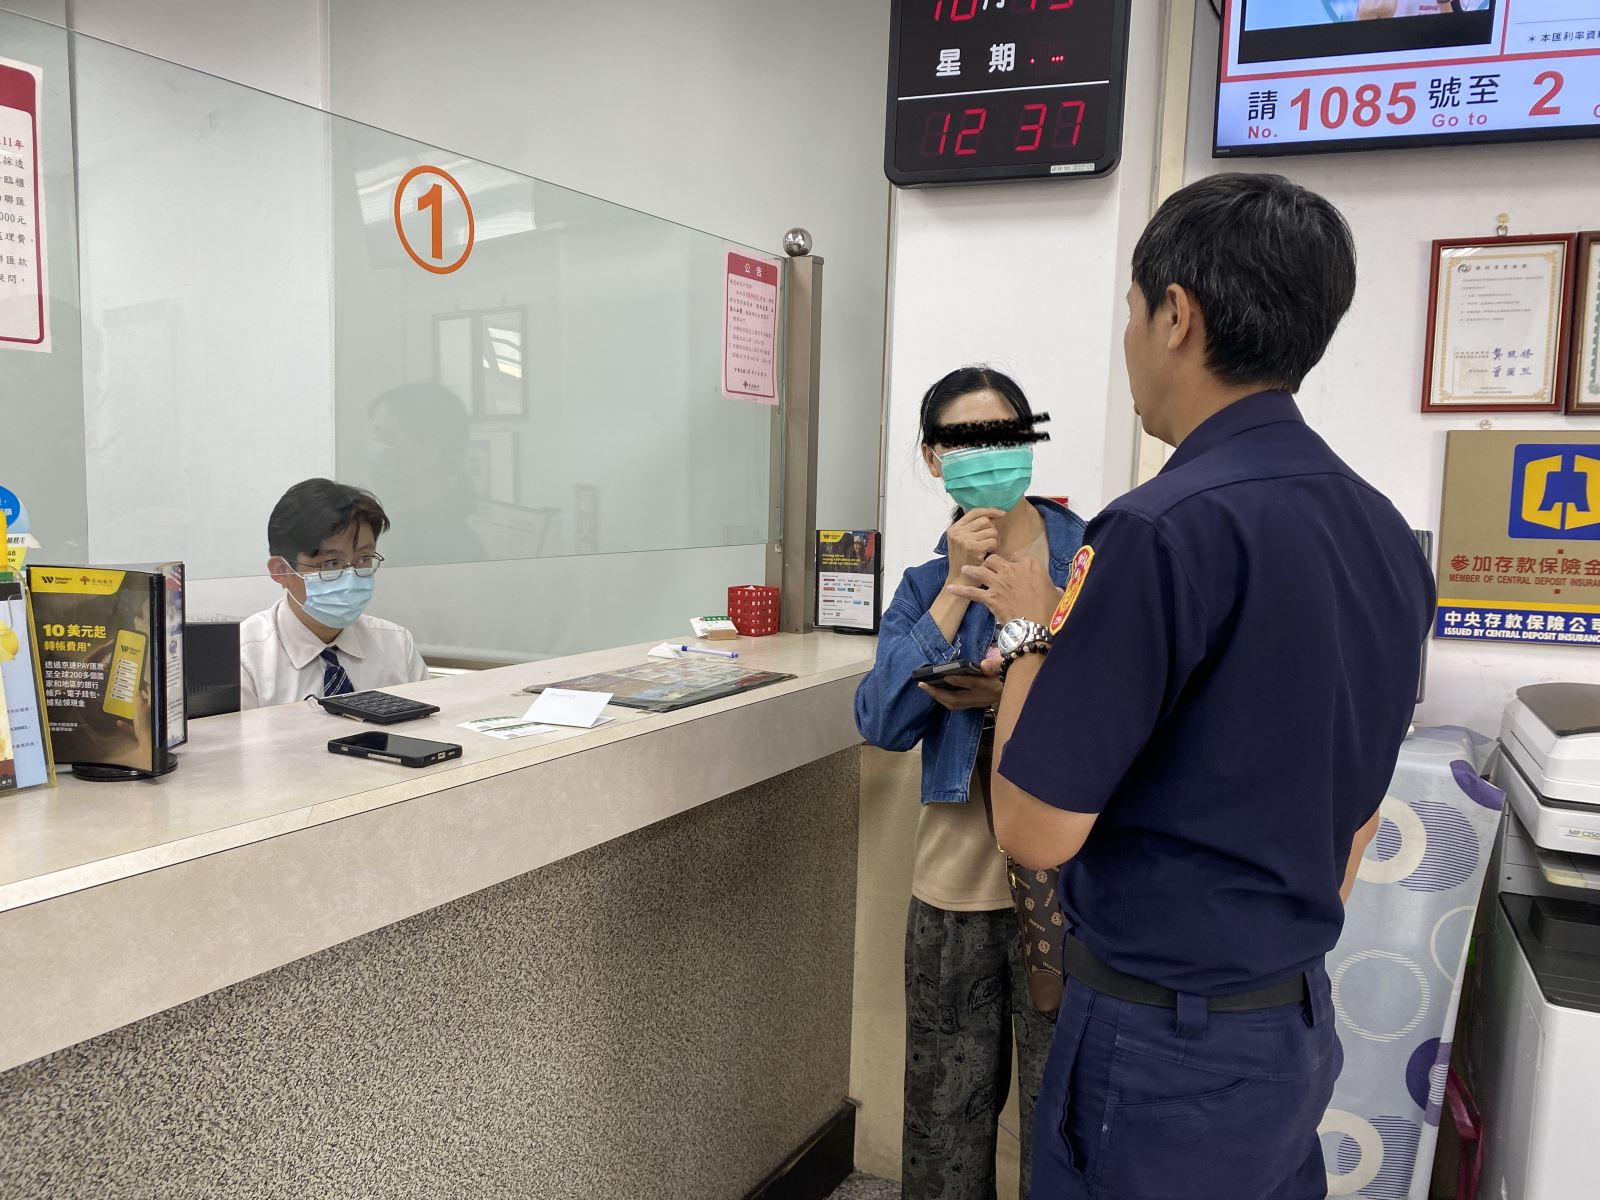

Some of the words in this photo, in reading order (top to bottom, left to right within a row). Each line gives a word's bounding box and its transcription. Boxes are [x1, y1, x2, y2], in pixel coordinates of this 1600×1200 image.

[1248, 90, 1278, 121] 請
[1290, 81, 1417, 131] 1085
[1428, 74, 1501, 109] 號至
[1528, 70, 1565, 116] 2
[937, 108, 987, 156] 12
[1015, 100, 1085, 152] 37
[1247, 126, 1278, 139] No.
[1432, 114, 1459, 127] Go
[1468, 112, 1488, 125] to
[0, 136, 25, 150] 11年
[0, 156, 25, 169] 採透
[0, 176, 25, 188] 臨櫃
[418, 183, 443, 260] 1
[744, 263, 762, 278] 公告
[1449, 573, 1480, 583] MEMBER
[1484, 575, 1494, 584] OF
[1497, 575, 1531, 585] CENTRAL
[1535, 577, 1567, 586] DEPOSIT
[43, 624, 65, 637] 10
[67, 624, 107, 639] 美元起
[1444, 627, 1472, 636] ISSUED
[1474, 629, 1485, 637] BY
[1486, 629, 1521, 639] CENTRAL
[1522, 631, 1557, 640] DEPOSIT
